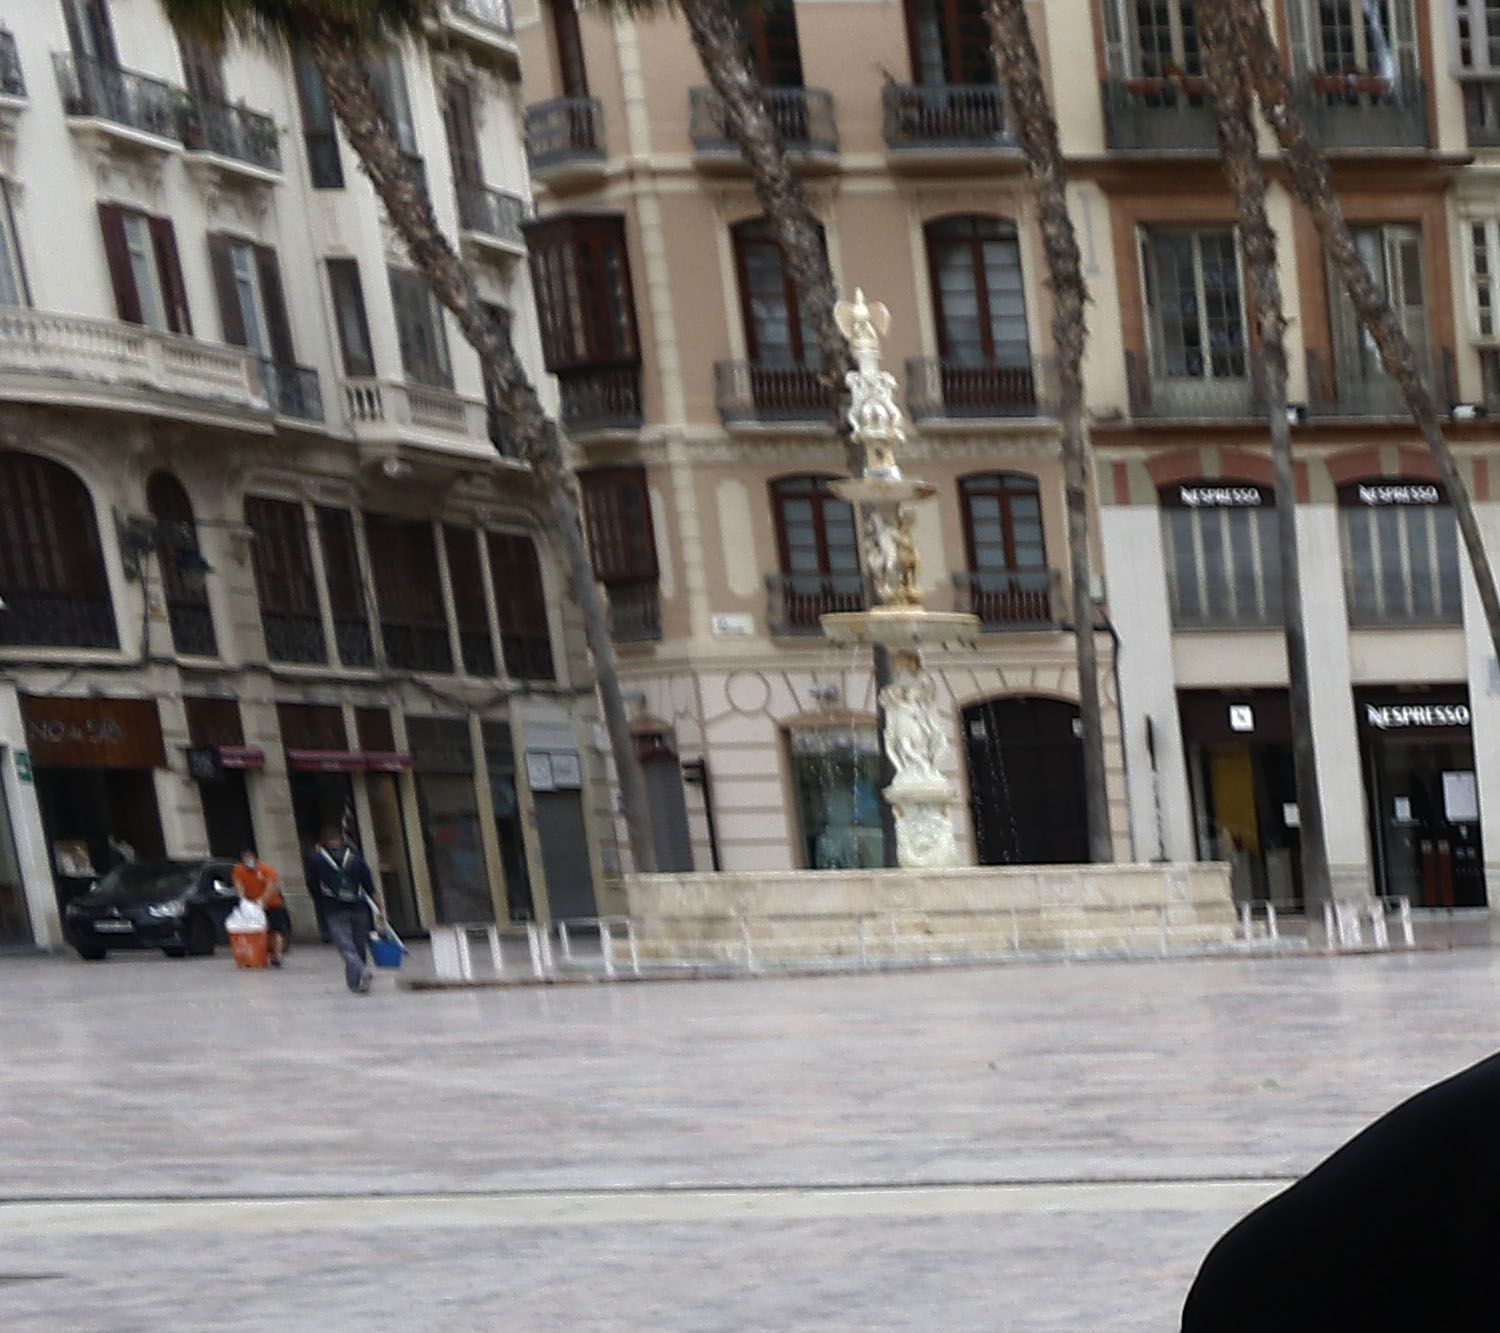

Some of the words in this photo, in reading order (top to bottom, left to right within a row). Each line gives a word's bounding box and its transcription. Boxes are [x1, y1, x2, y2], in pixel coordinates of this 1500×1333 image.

[1181, 484, 1261, 506] NESPRESSO
[1359, 484, 1438, 505] NESPRESSO
[1365, 703, 1470, 730] NESPRESSO
